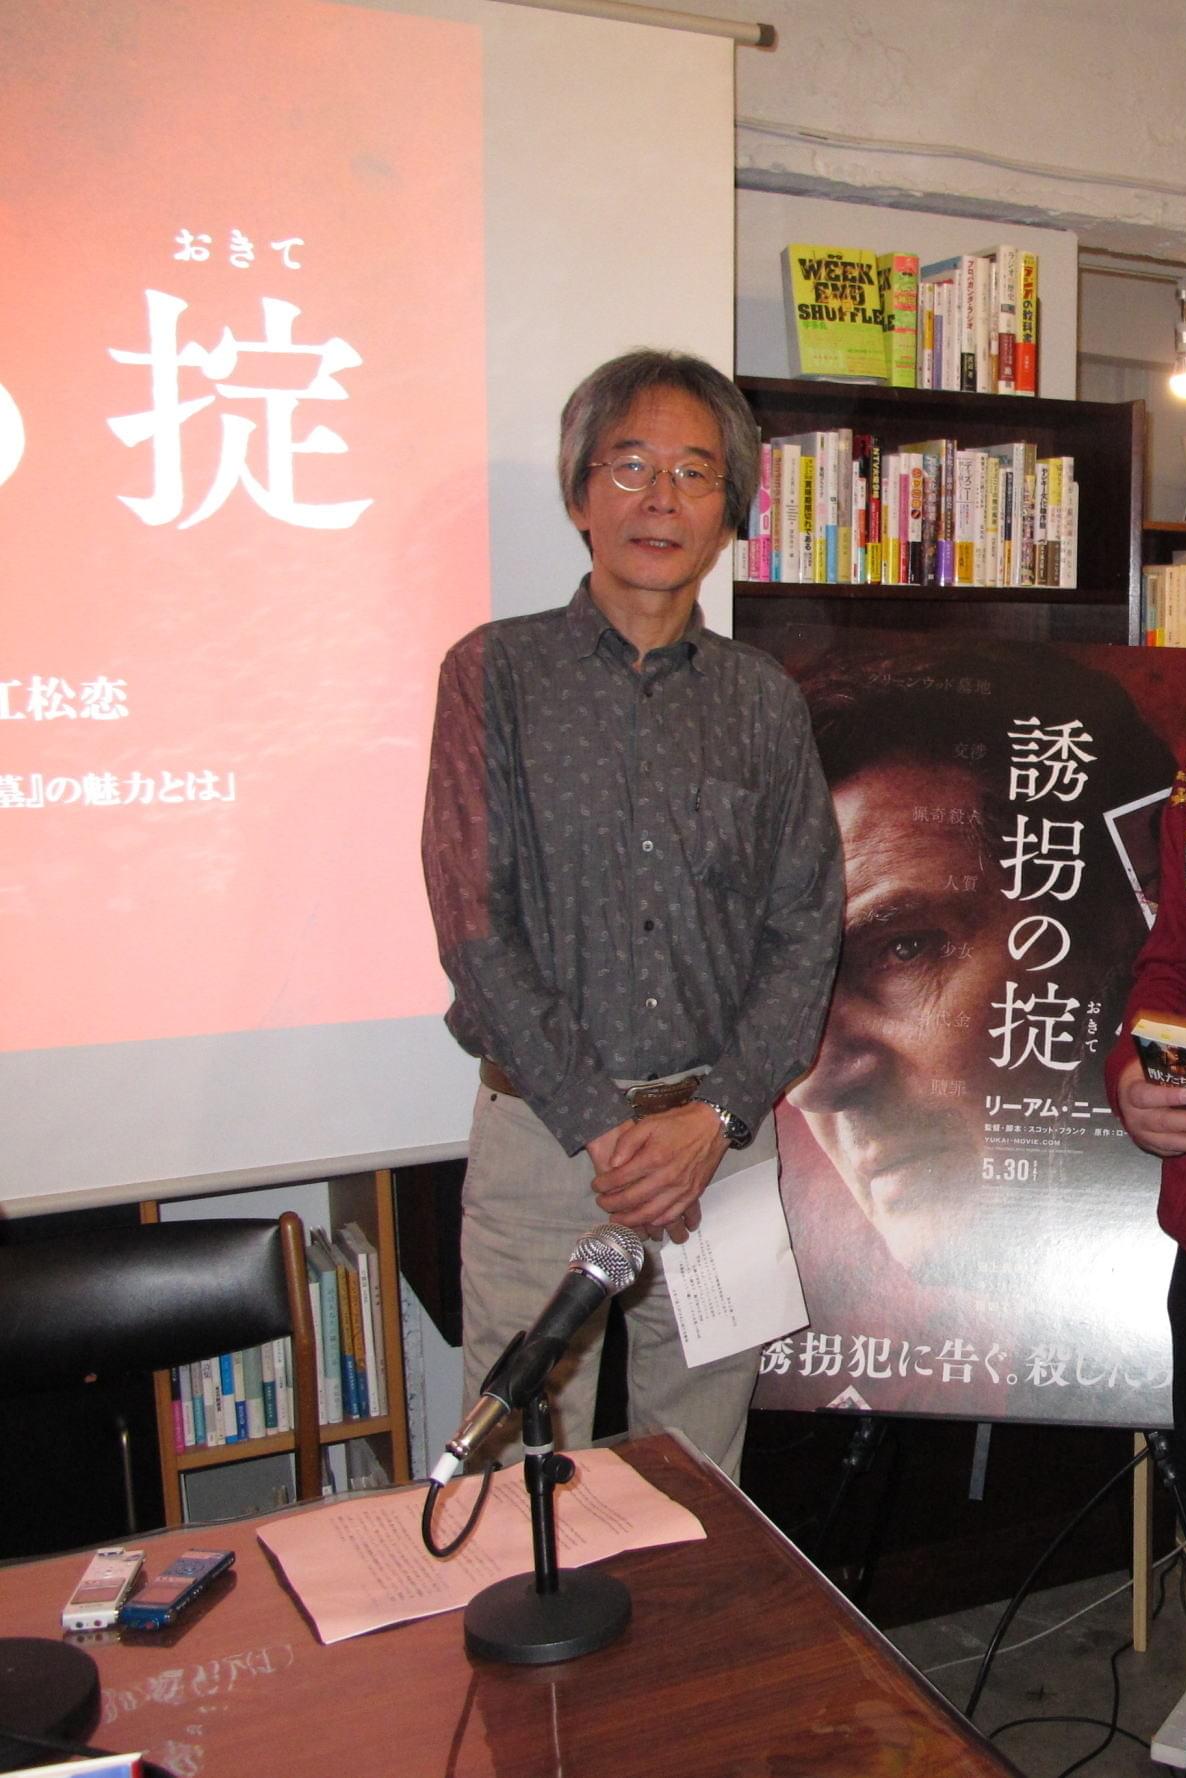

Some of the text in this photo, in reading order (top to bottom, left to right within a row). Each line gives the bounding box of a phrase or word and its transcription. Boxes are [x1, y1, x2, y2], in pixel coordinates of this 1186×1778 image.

[173, 228, 305, 270] おきて
[0, 288, 374, 530] 掟
[945, 874, 979, 893] 人質
[987, 715, 1099, 1071] 誘拐の掟
[940, 940, 974, 960] 少女
[1085, 1000, 1102, 1053] おきて
[985, 1095, 1113, 1119] リーアム・ニー
[981, 1157, 1030, 1182] 5.30
